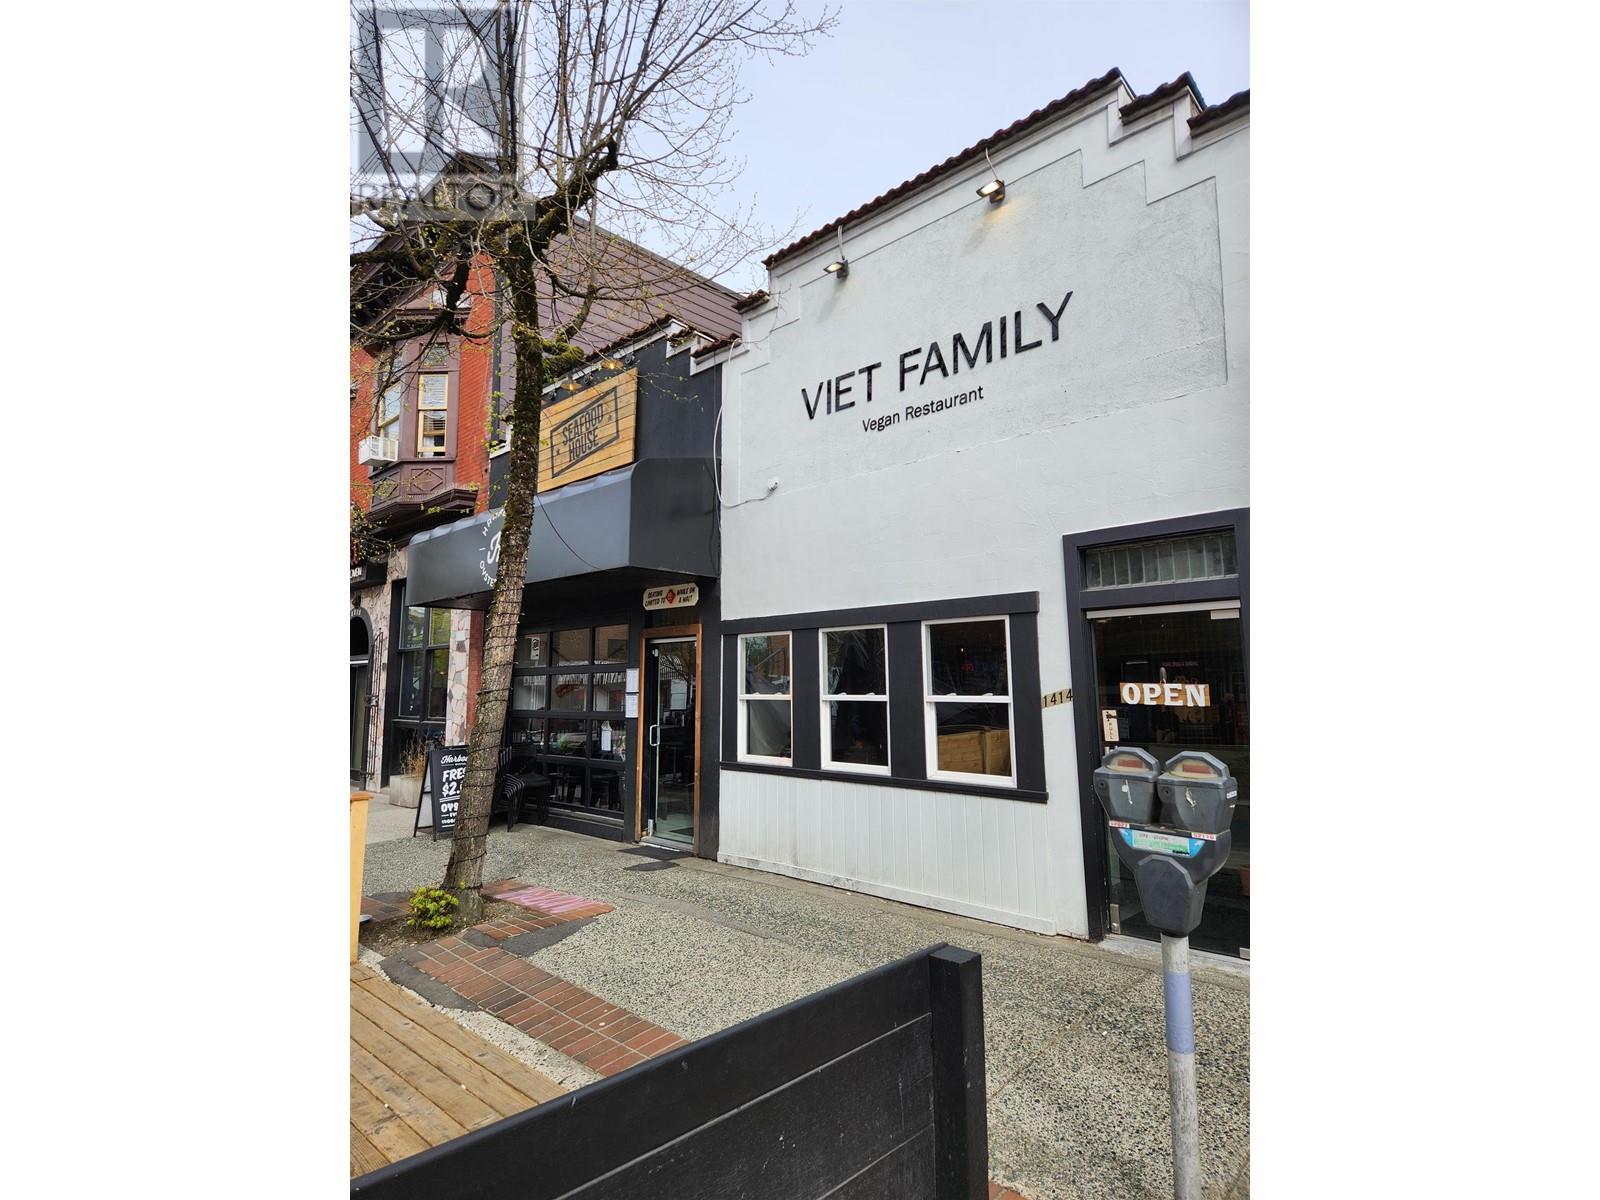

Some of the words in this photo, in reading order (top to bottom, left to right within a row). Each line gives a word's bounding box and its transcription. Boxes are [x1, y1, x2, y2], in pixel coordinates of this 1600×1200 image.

[801, 361, 882, 420] VIET
[899, 290, 1074, 392] FAMILY
[562, 402, 604, 446] SEAFOOD
[862, 412, 900, 433] Vegan
[904, 385, 984, 420] Restaurant
[568, 427, 600, 462] HOUSE
[1042, 689, 1073, 707] 1414
[1122, 682, 1206, 708] OPEN
